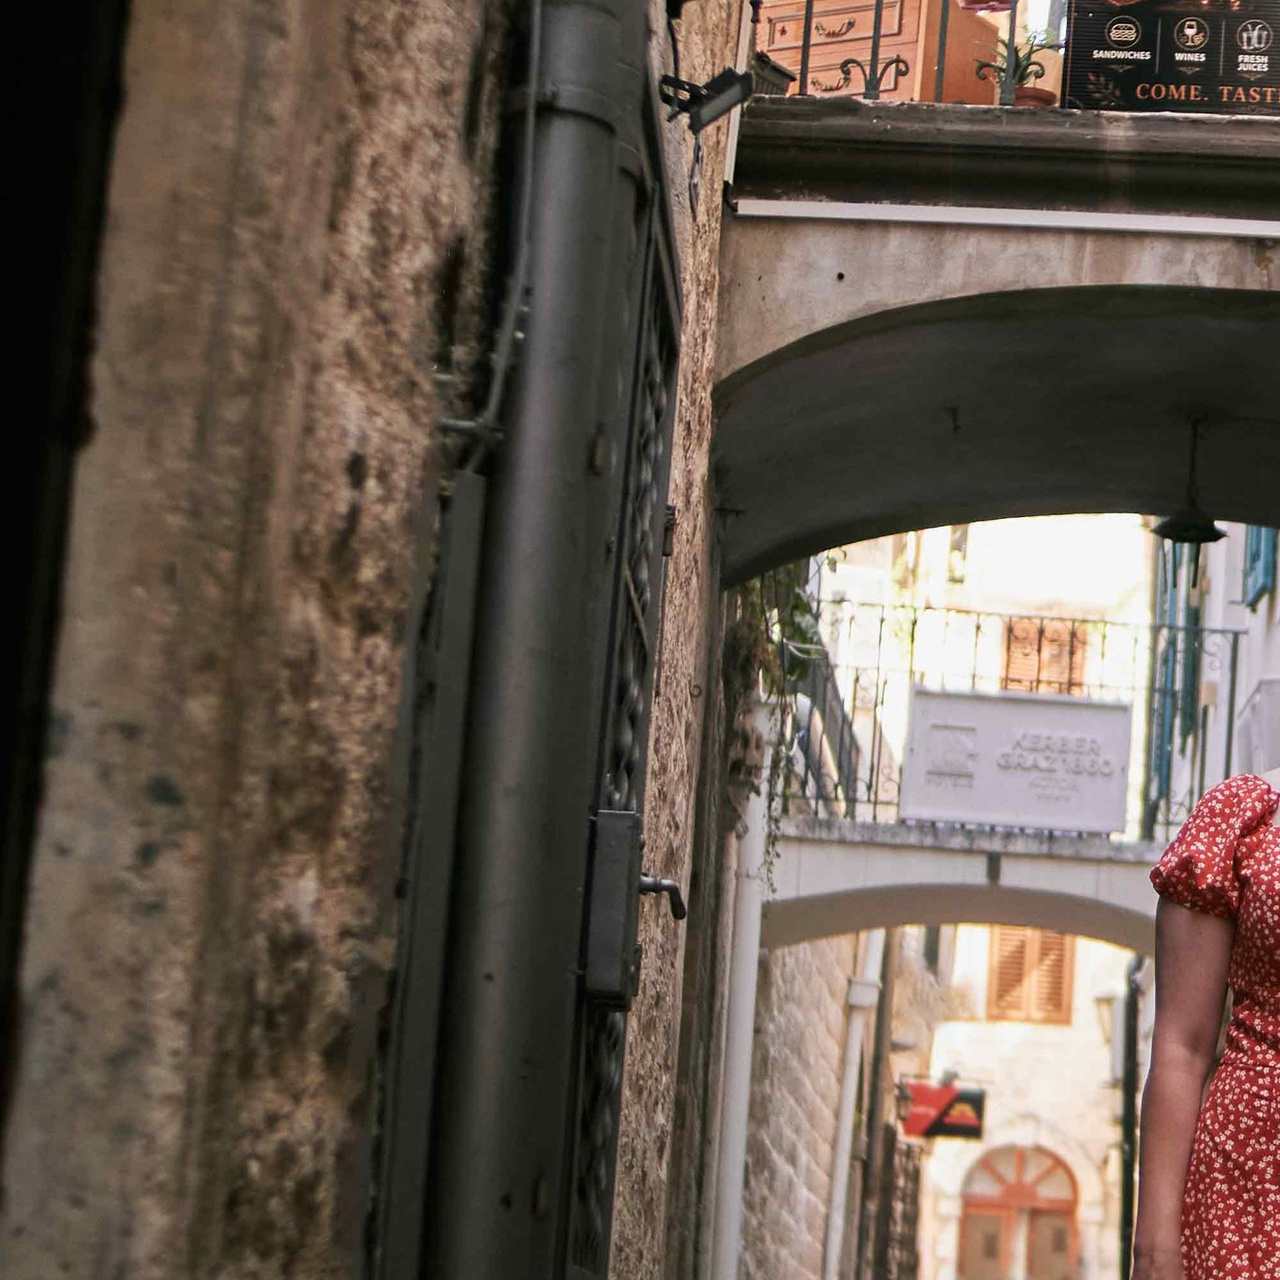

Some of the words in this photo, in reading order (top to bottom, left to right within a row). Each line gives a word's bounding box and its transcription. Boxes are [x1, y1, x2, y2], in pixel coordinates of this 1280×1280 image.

[1092, 49, 1152, 61] SANDWICHES
[1174, 52, 1206, 62] WINES
[1237, 55, 1269, 64] FRESH
[1236, 63, 1269, 72] JUICES
[1135, 83, 1209, 101] COME.
